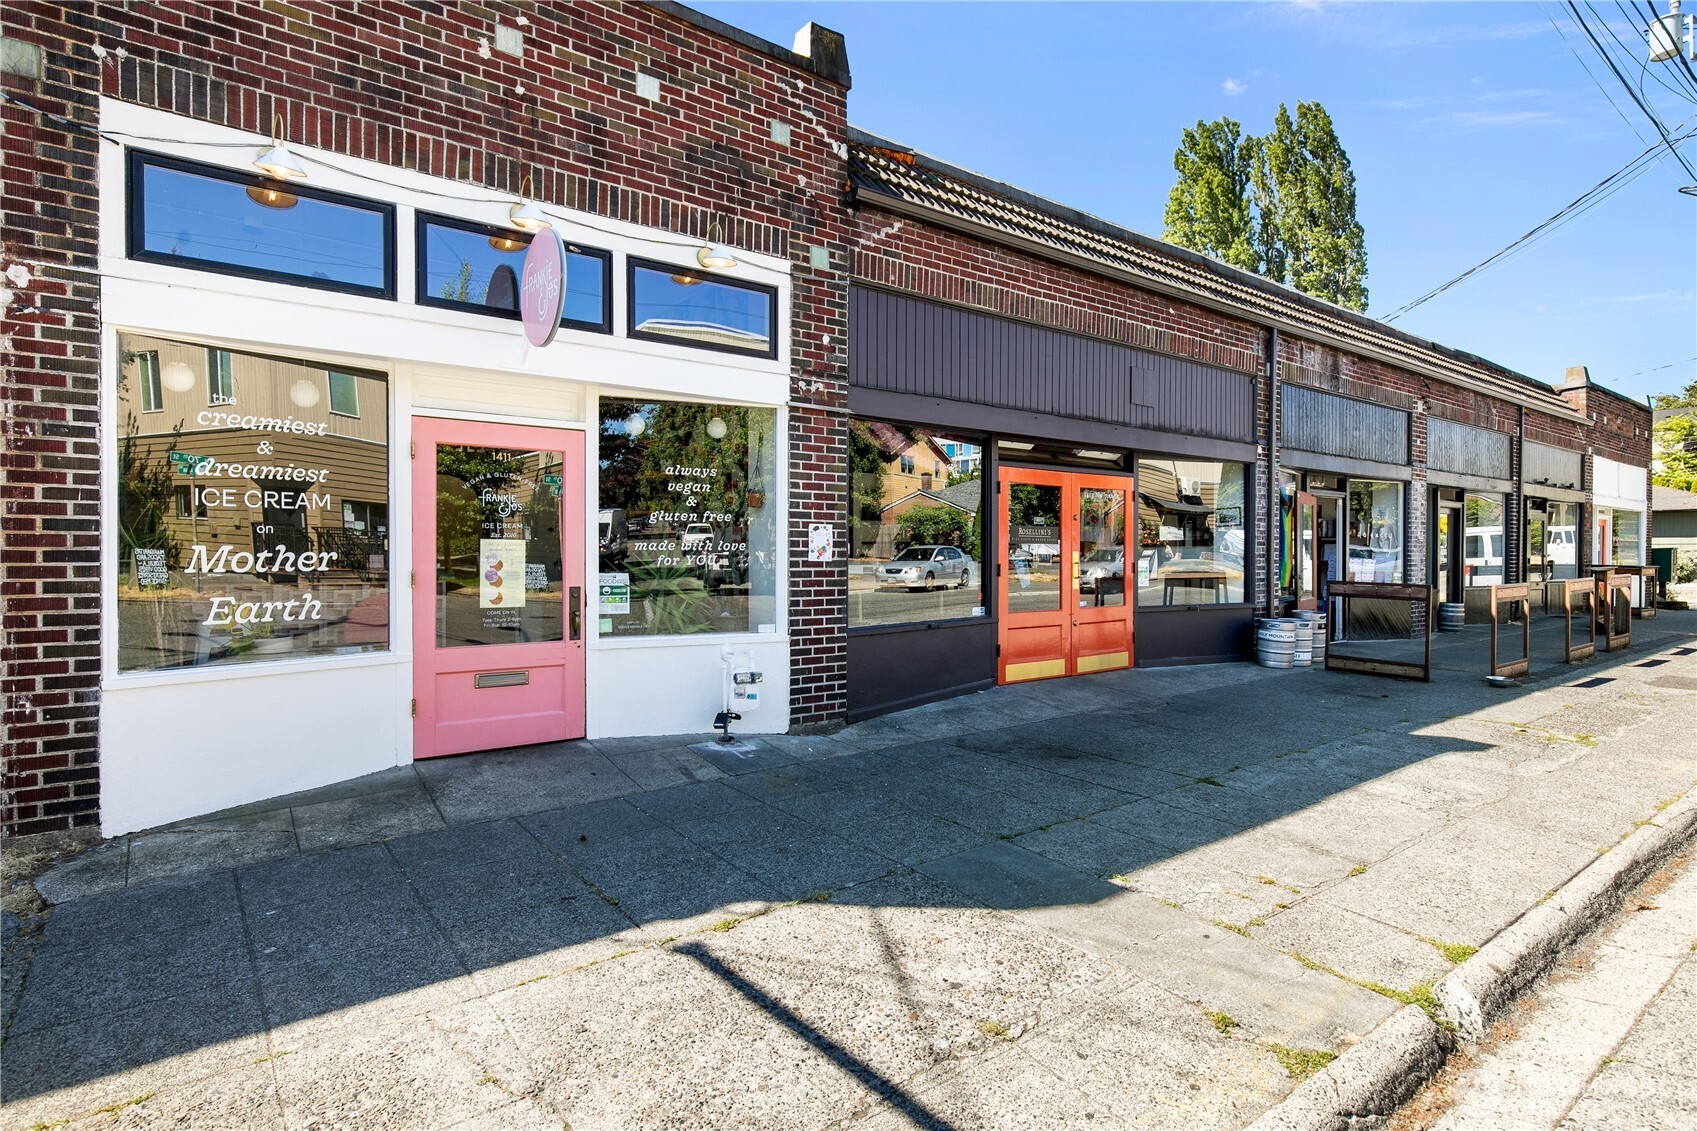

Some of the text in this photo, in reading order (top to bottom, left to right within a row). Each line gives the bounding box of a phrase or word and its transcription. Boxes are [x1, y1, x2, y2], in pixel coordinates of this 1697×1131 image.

[523, 260, 553, 308] FRANKIE
[212, 392, 237, 406] the
[197, 411, 328, 437] creamiest
[256, 440, 274, 455] &
[491, 451, 511, 462] 1411
[195, 457, 330, 483] dreamiest
[665, 464, 718, 478] always
[462, 475, 485, 490] VEGAN
[667, 482, 711, 495] vegan
[195, 487, 331, 510] ICE CREAM
[478, 488, 516, 507] FRANKIE
[686, 496, 698, 507] &
[649, 510, 732, 524] gluten free
[256, 525, 274, 534] on
[1018, 527, 1052, 536] ROSELLINI'S
[634, 540, 746, 551] made with love
[184, 544, 338, 574] Mother
[656, 554, 718, 567] for YOU
[202, 593, 322, 626] Earth
